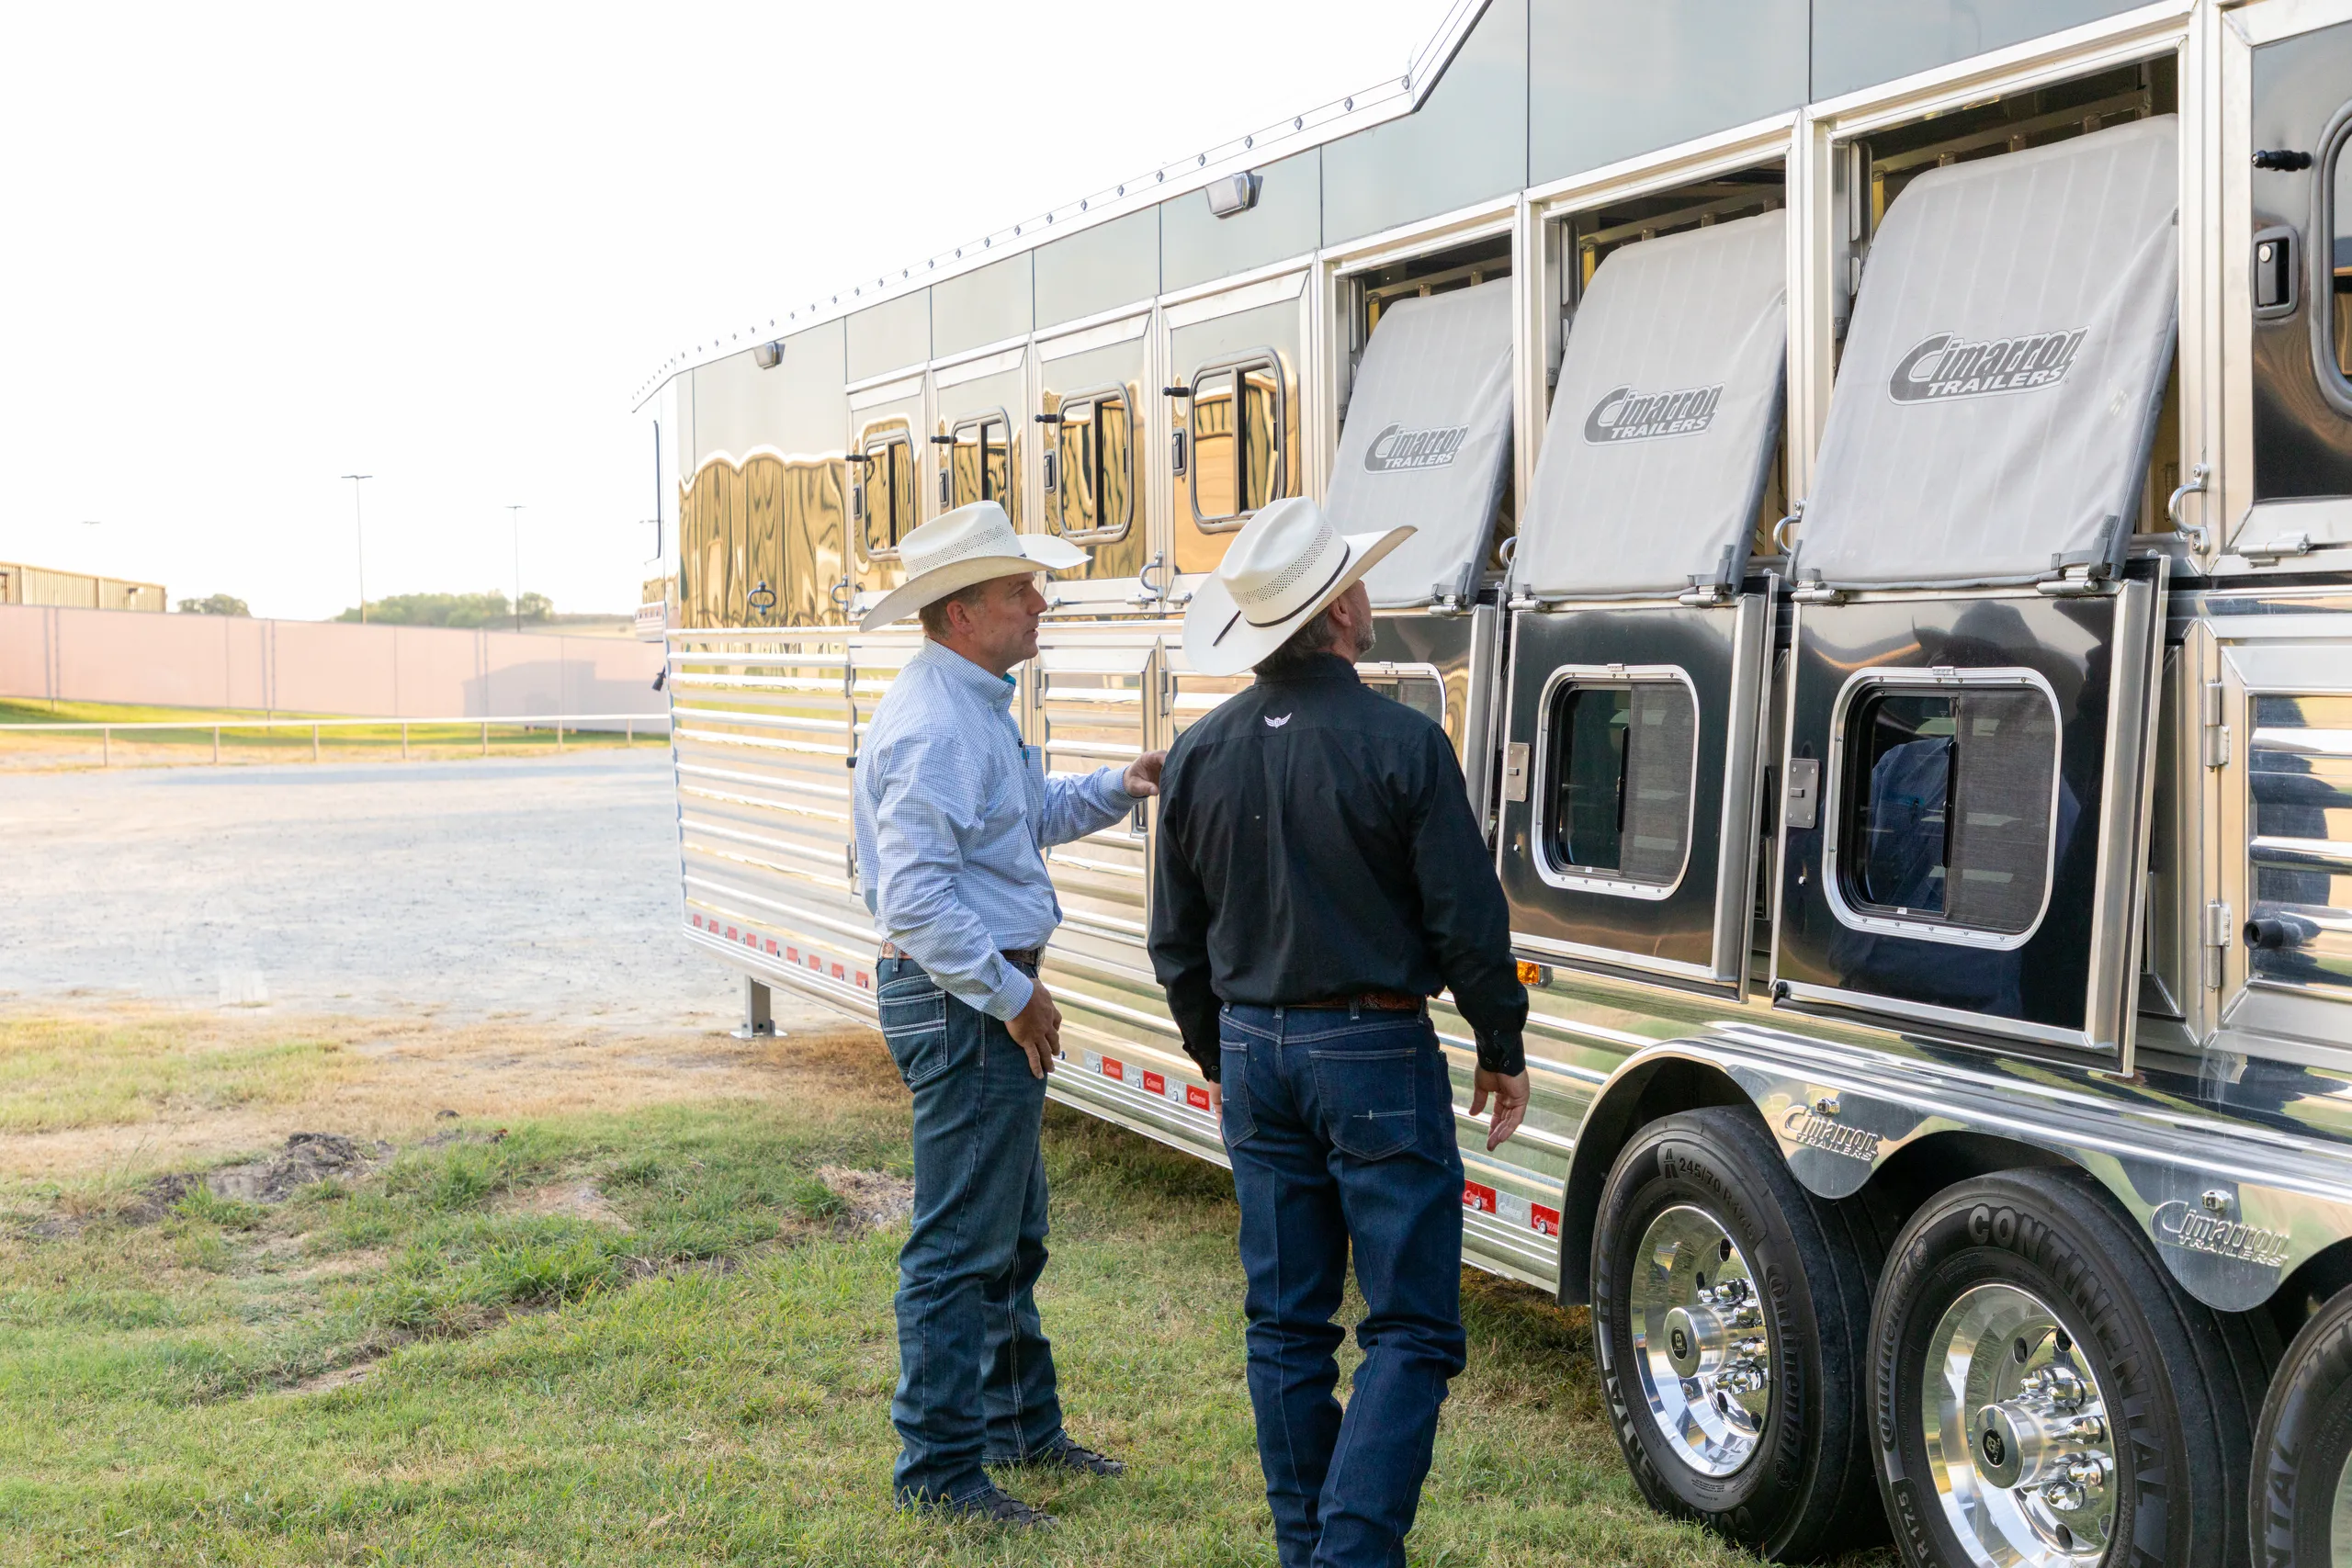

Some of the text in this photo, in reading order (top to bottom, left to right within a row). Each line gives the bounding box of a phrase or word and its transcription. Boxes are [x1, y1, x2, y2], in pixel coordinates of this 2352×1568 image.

[1888, 327, 2090, 402] Cimarron
[1927, 365, 2064, 397] TRAILERS
[1583, 384, 1724, 443] Cimarron
[1611, 416, 1709, 439] TRAILERS
[1363, 423, 1469, 472] Cimarron
[1384, 452, 1454, 469] TRAILERS
[1779, 1104, 1879, 1154] Cimarron
[1796, 1133, 1872, 1161] TRAILERS
[1679, 1157, 1722, 1195] 245/70
[2150, 1200, 2289, 1259] Cimarron
[2178, 1235, 2284, 1267] TRAILERS
[1968, 1203, 2168, 1506] CONTINENTAL
[1897, 1491, 1929, 1560] R 17.5
